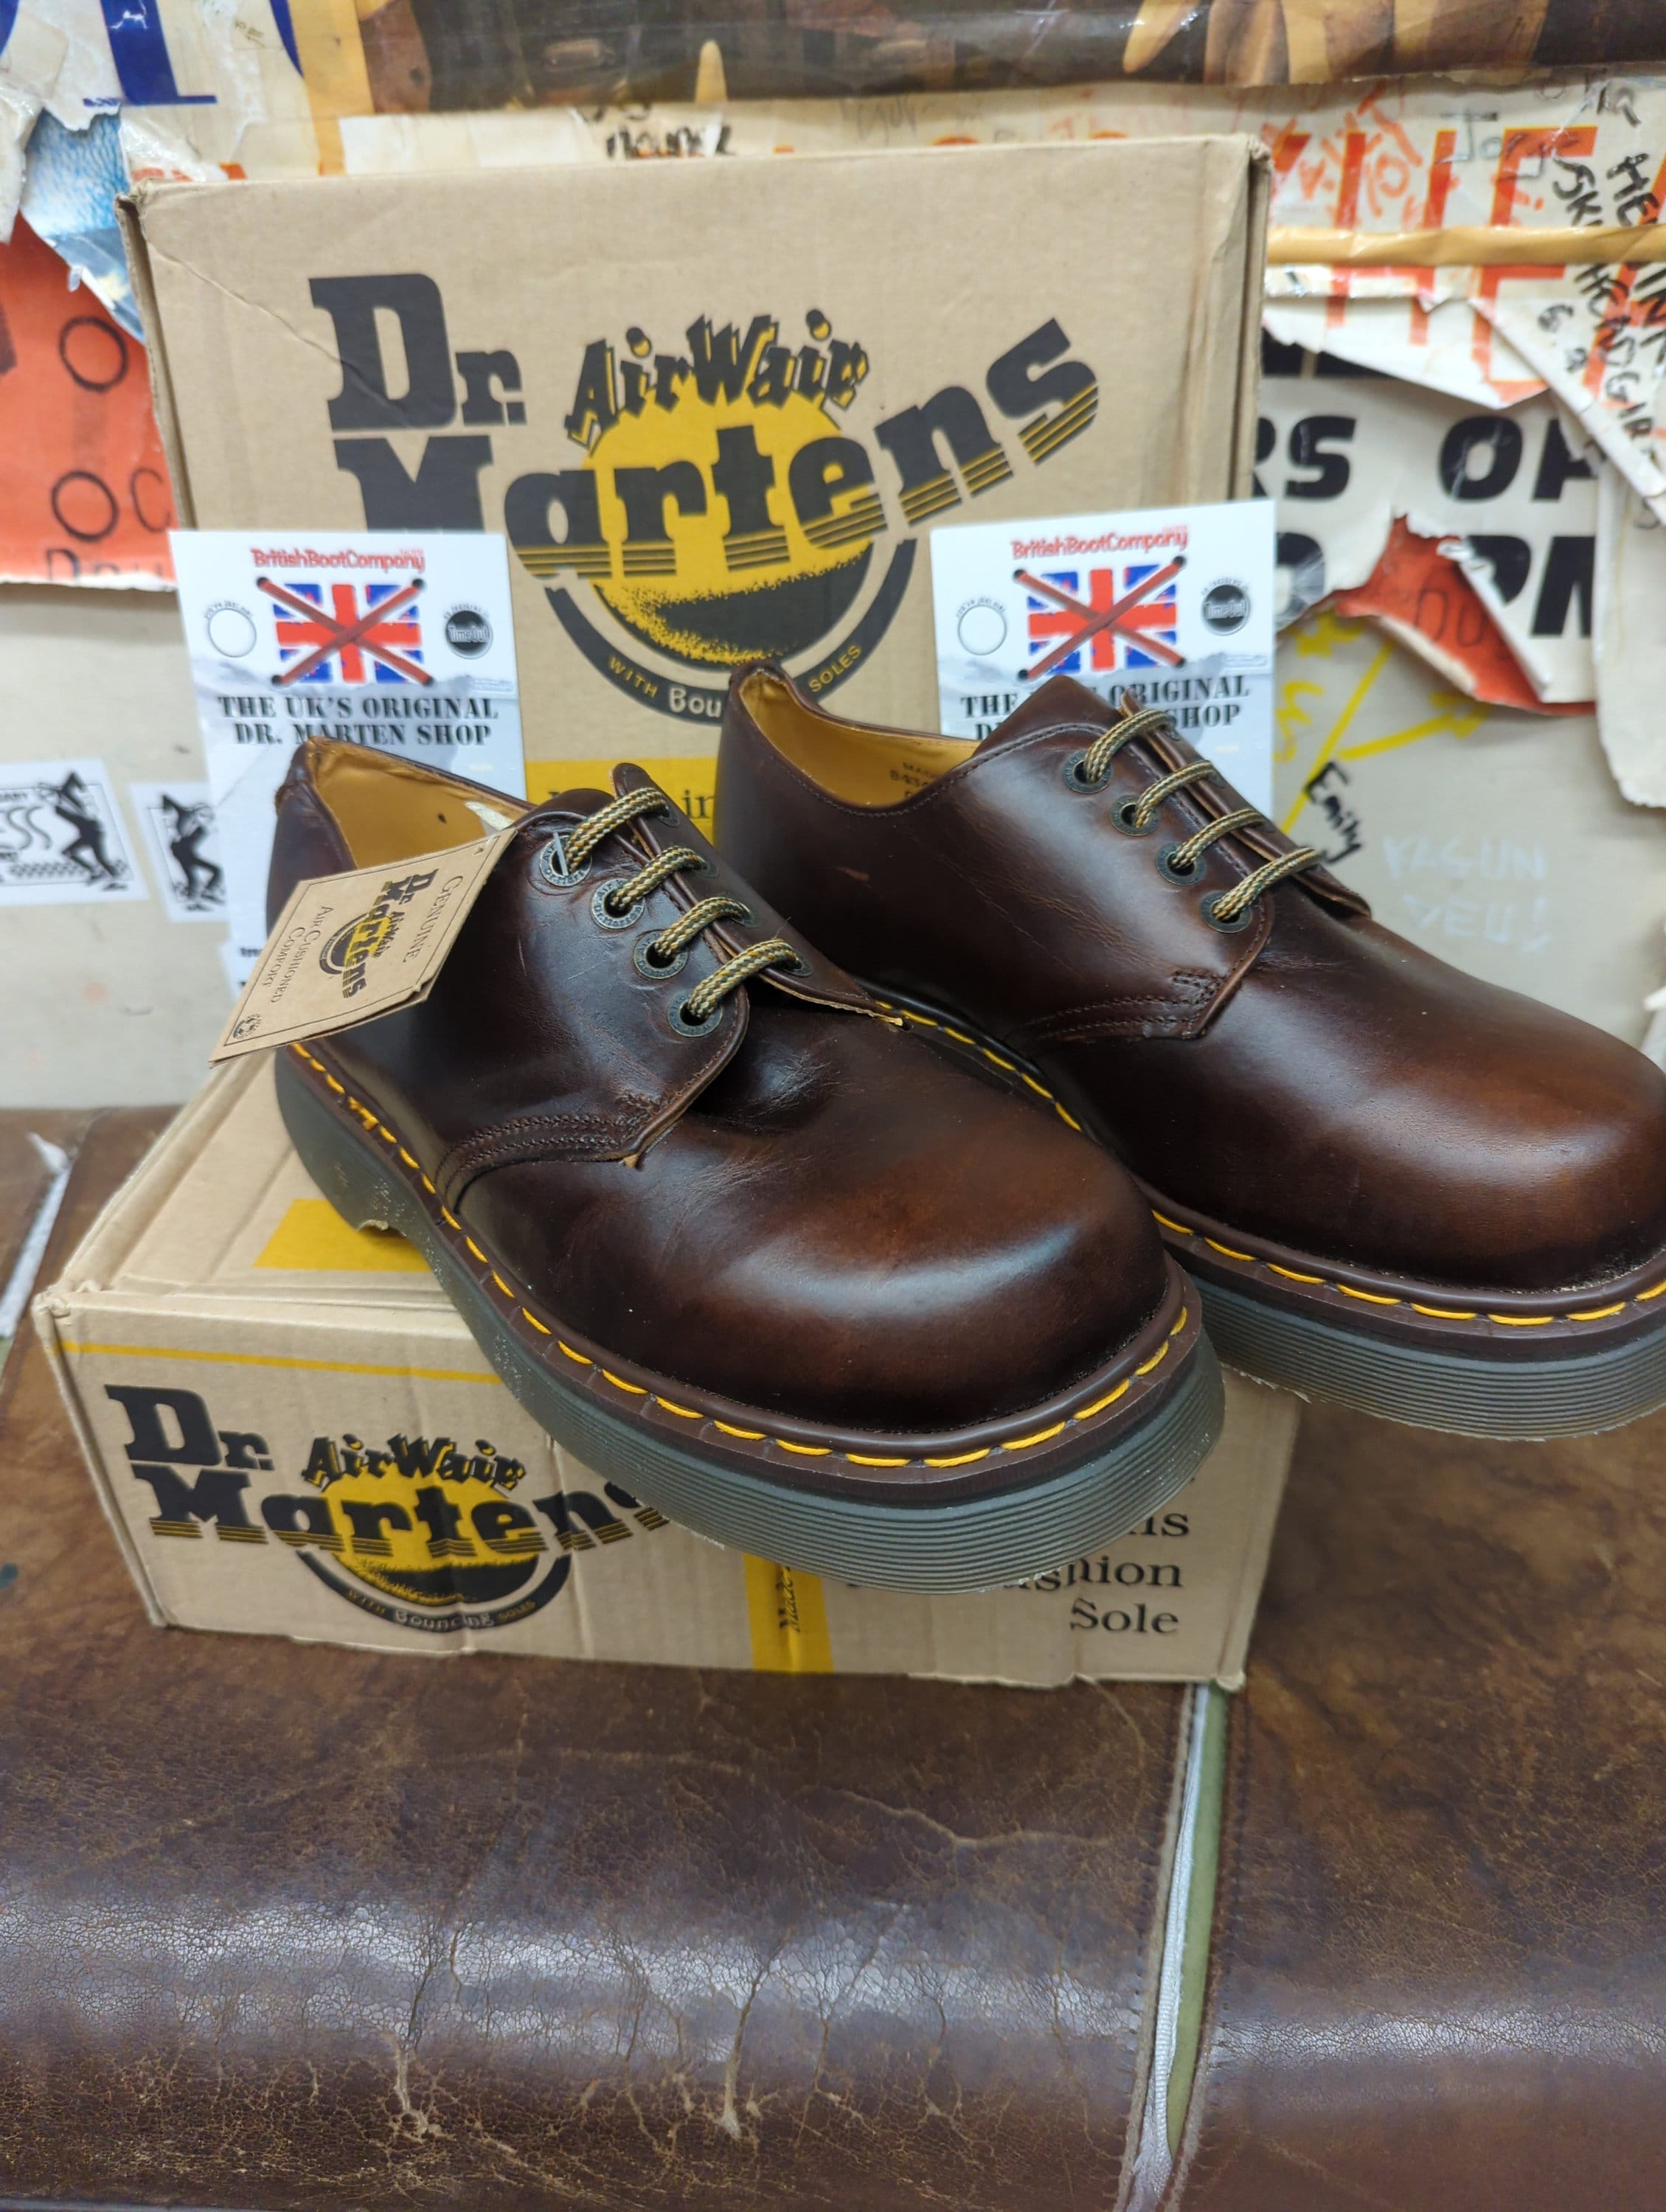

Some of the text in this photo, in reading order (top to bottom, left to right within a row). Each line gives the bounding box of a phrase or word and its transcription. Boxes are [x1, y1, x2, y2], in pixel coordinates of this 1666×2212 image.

[309, 273, 527, 431] Dr.
[566, 309, 869, 448] AirWair
[333, 318, 1098, 577] Martens
[609, 655, 659, 699] WITH
[808, 644, 862, 693] SOLES
[219, 696, 499, 720] THE UK'S ORIGINAL
[235, 723, 283, 745] DR.
[417, 724, 491, 746] SHOP
[342, 876, 412, 998] Martens
[403, 874, 464, 964] GENUINE
[105, 1384, 275, 1471] Dr.
[301, 1433, 527, 1493] AirWair
[1070, 1597, 1179, 1634] Sole
